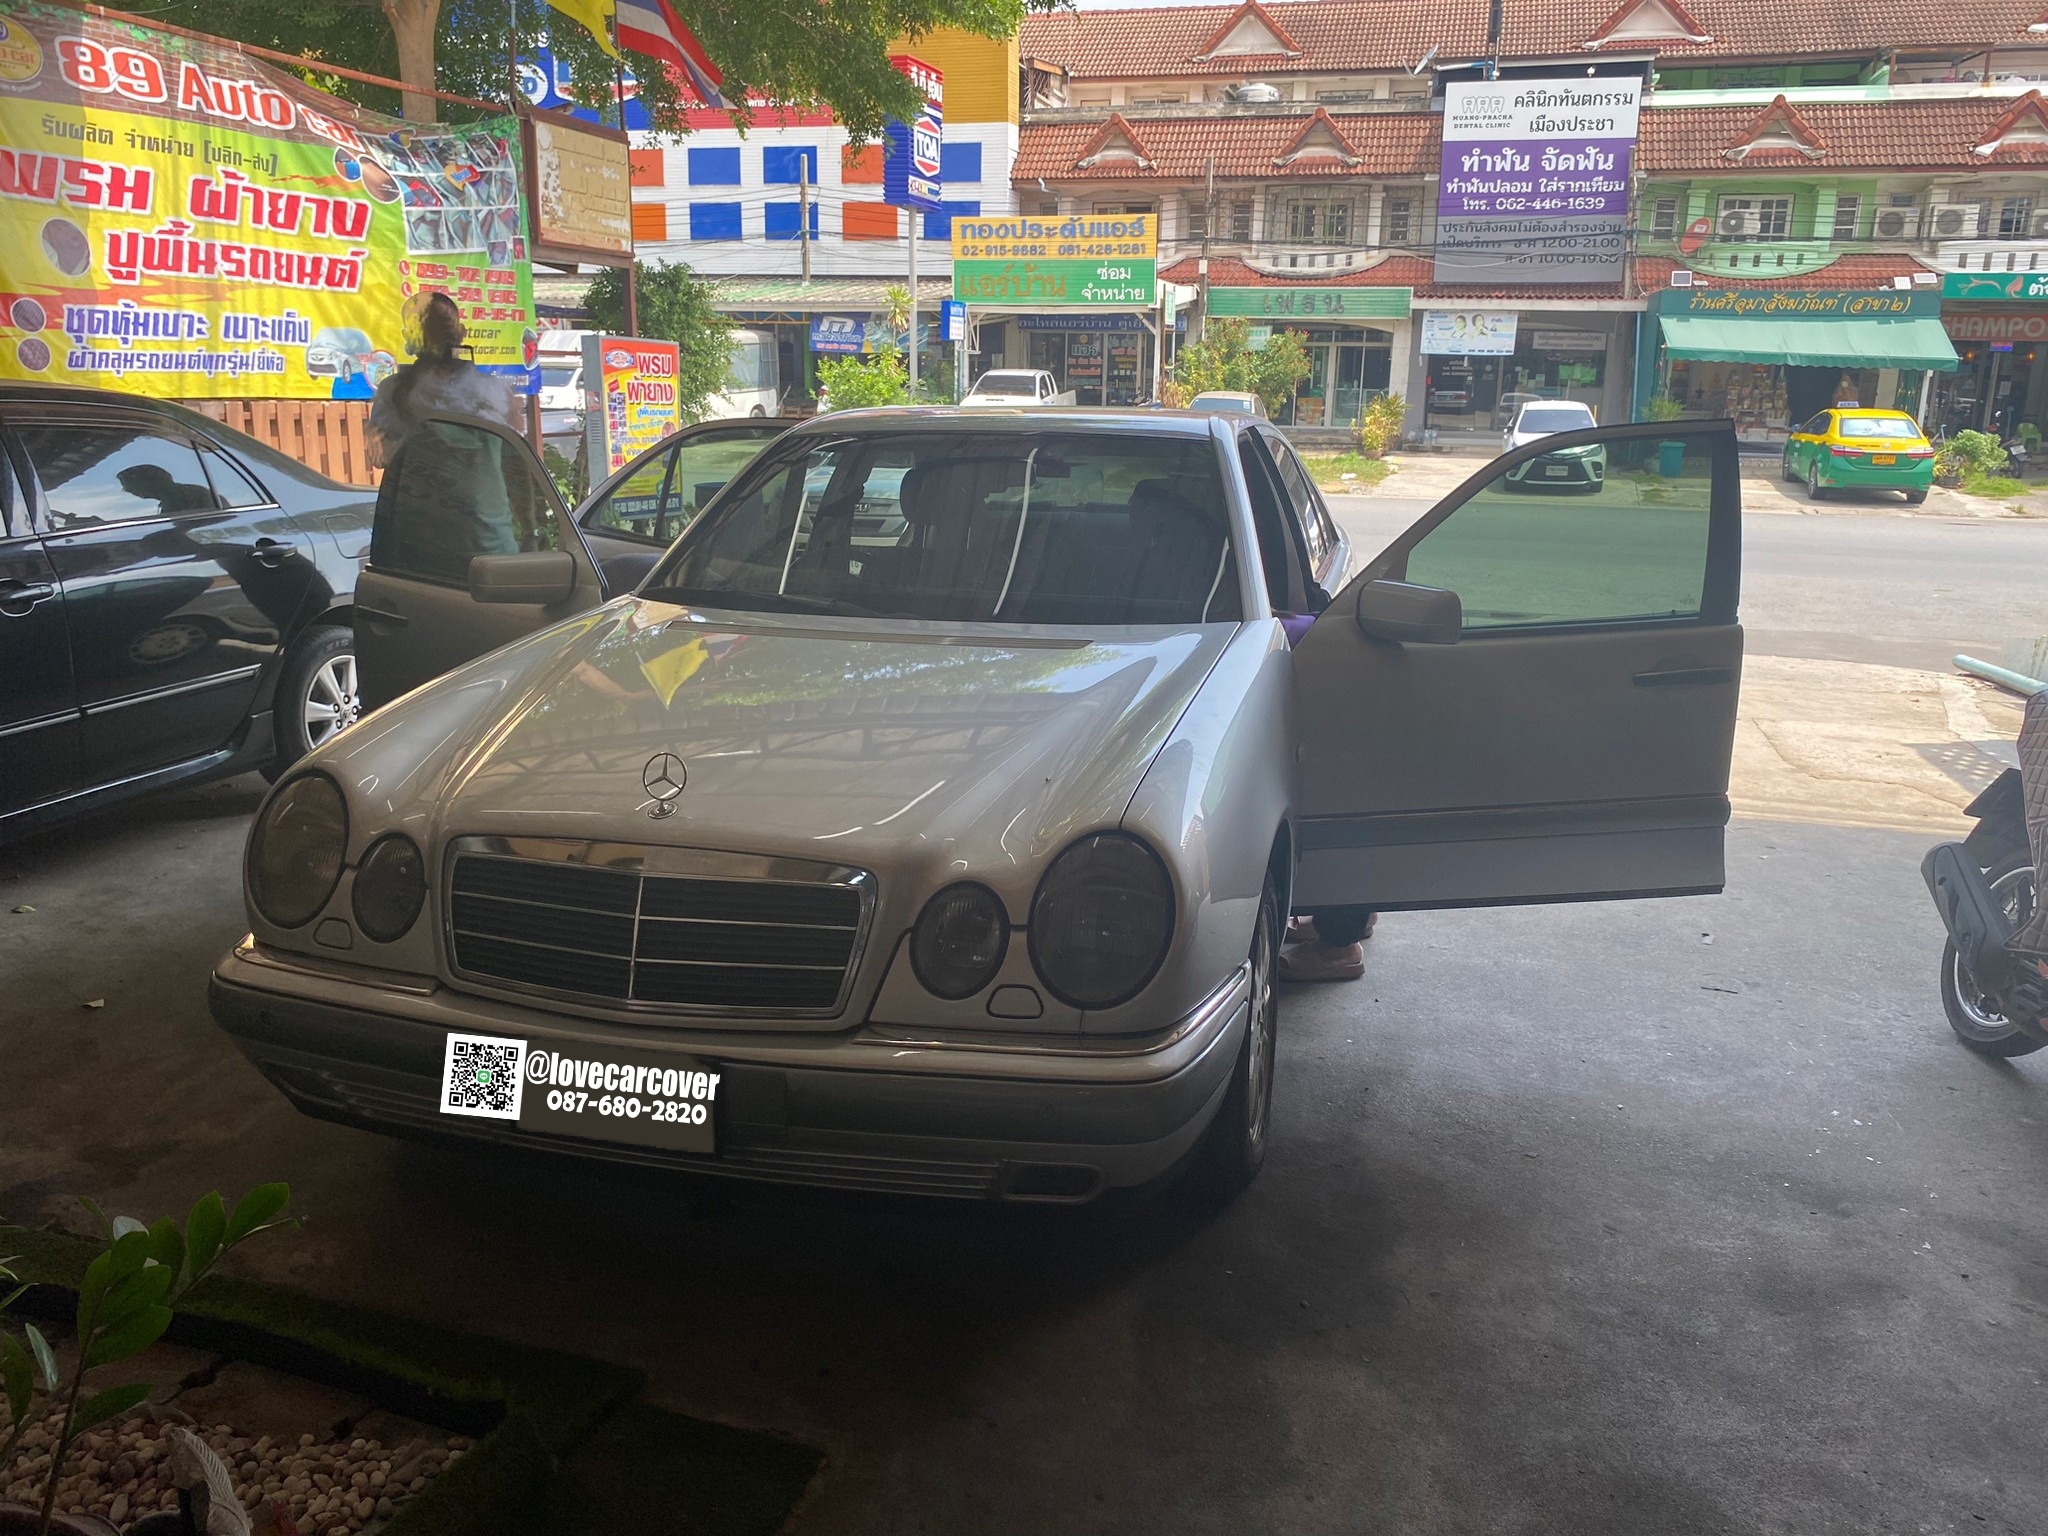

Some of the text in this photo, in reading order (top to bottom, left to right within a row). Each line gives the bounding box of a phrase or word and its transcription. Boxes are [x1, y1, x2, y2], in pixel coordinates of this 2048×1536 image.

[55, 35, 367, 153] 89 Auto car
[1514, 88, 1633, 108] คลินิกทันตกรรม
[42, 113, 114, 145] รับผลิต
[124, 128, 194, 158] จำหน่าย
[1529, 115, 1615, 133] เมืองประชา
[917, 131, 938, 162] TOA
[1461, 146, 1615, 172] ทำฟัน จัดฟัน
[0, 147, 373, 241] พรม ผ้ายาง
[1446, 176, 1626, 194] ทำฟันปลอม ใส่รากเทียม
[1462, 197, 1606, 211] โทร. 062-446-1639
[960, 216, 1146, 240] ทองประดับแอร์
[104, 217, 368, 293] ปูพื้นรถยนต์
[960, 262, 1067, 298] แอร์บ้าน
[1096, 261, 1132, 281] ซ่อม
[1081, 283, 1146, 301] จำหน่าย
[63, 298, 210, 347] ชุดหุ้มเบาะ
[636, 352, 673, 378] พรม
[626, 376, 675, 405] ผ้ายาง
